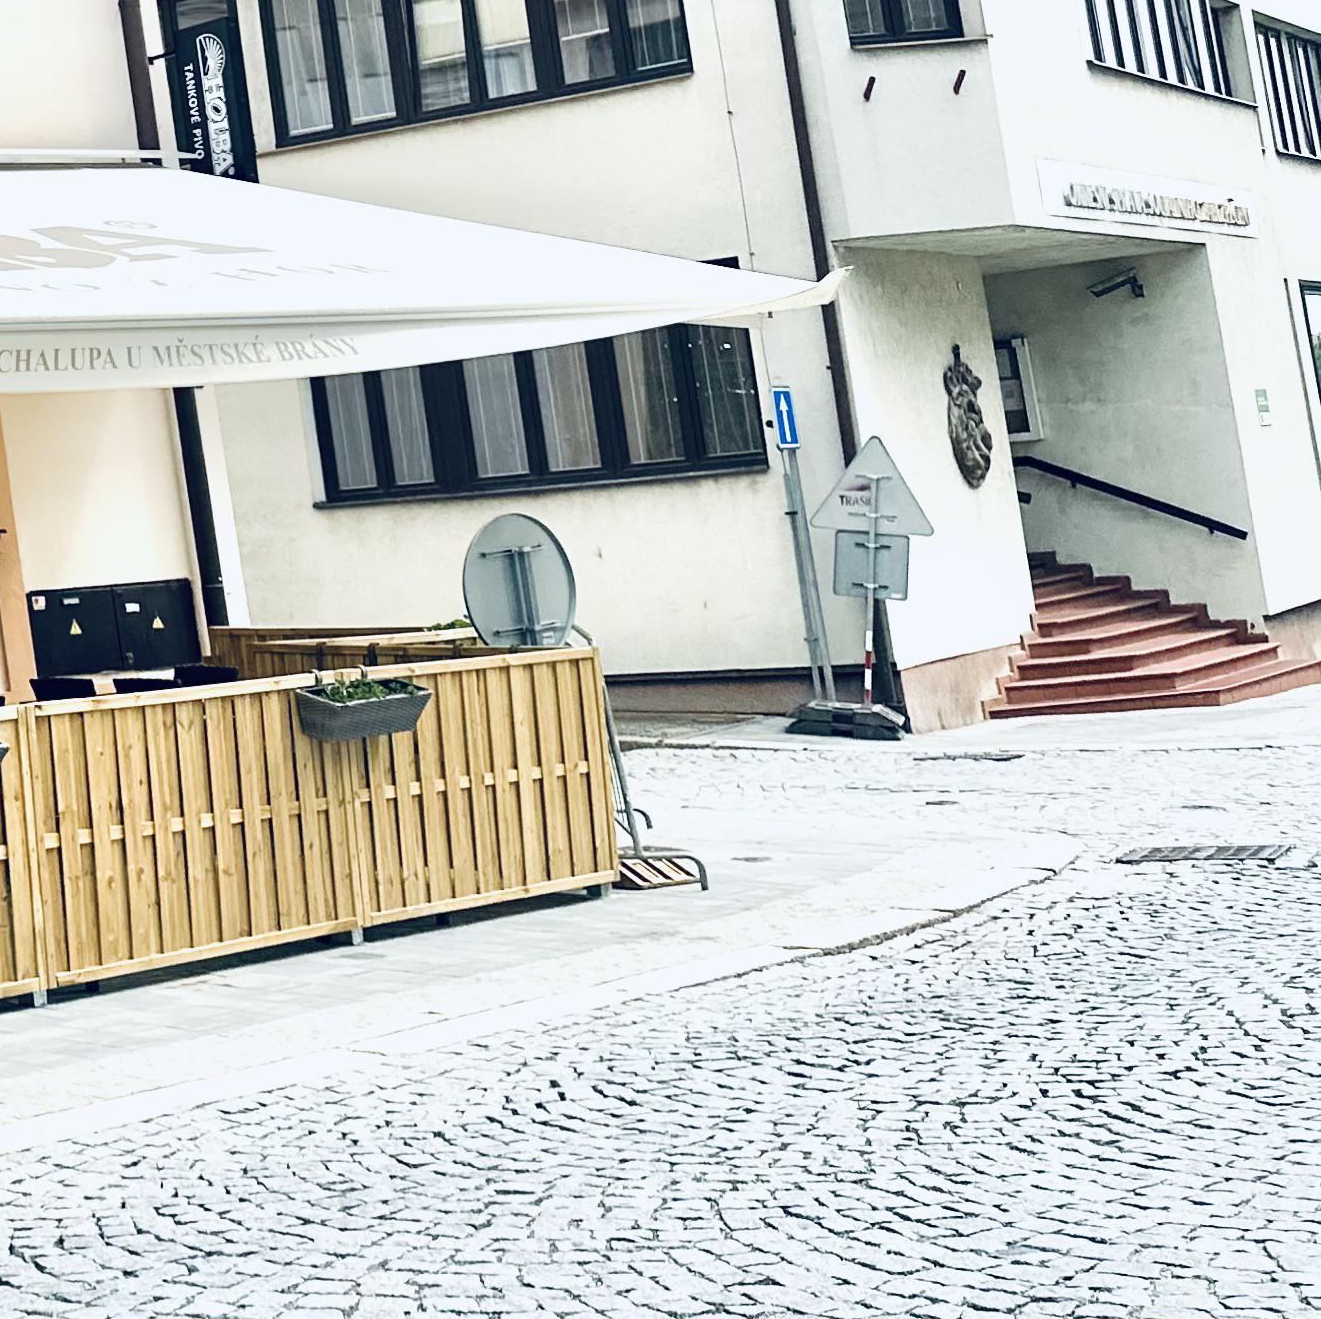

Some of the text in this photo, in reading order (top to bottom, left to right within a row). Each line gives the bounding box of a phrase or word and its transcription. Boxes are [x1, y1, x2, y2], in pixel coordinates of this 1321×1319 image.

[192, 128, 205, 160] PIVO
[126, 346, 143, 370] U
[152, 336, 271, 369] MĚSTSKÉ
[274, 334, 361, 363] BRÁNY
